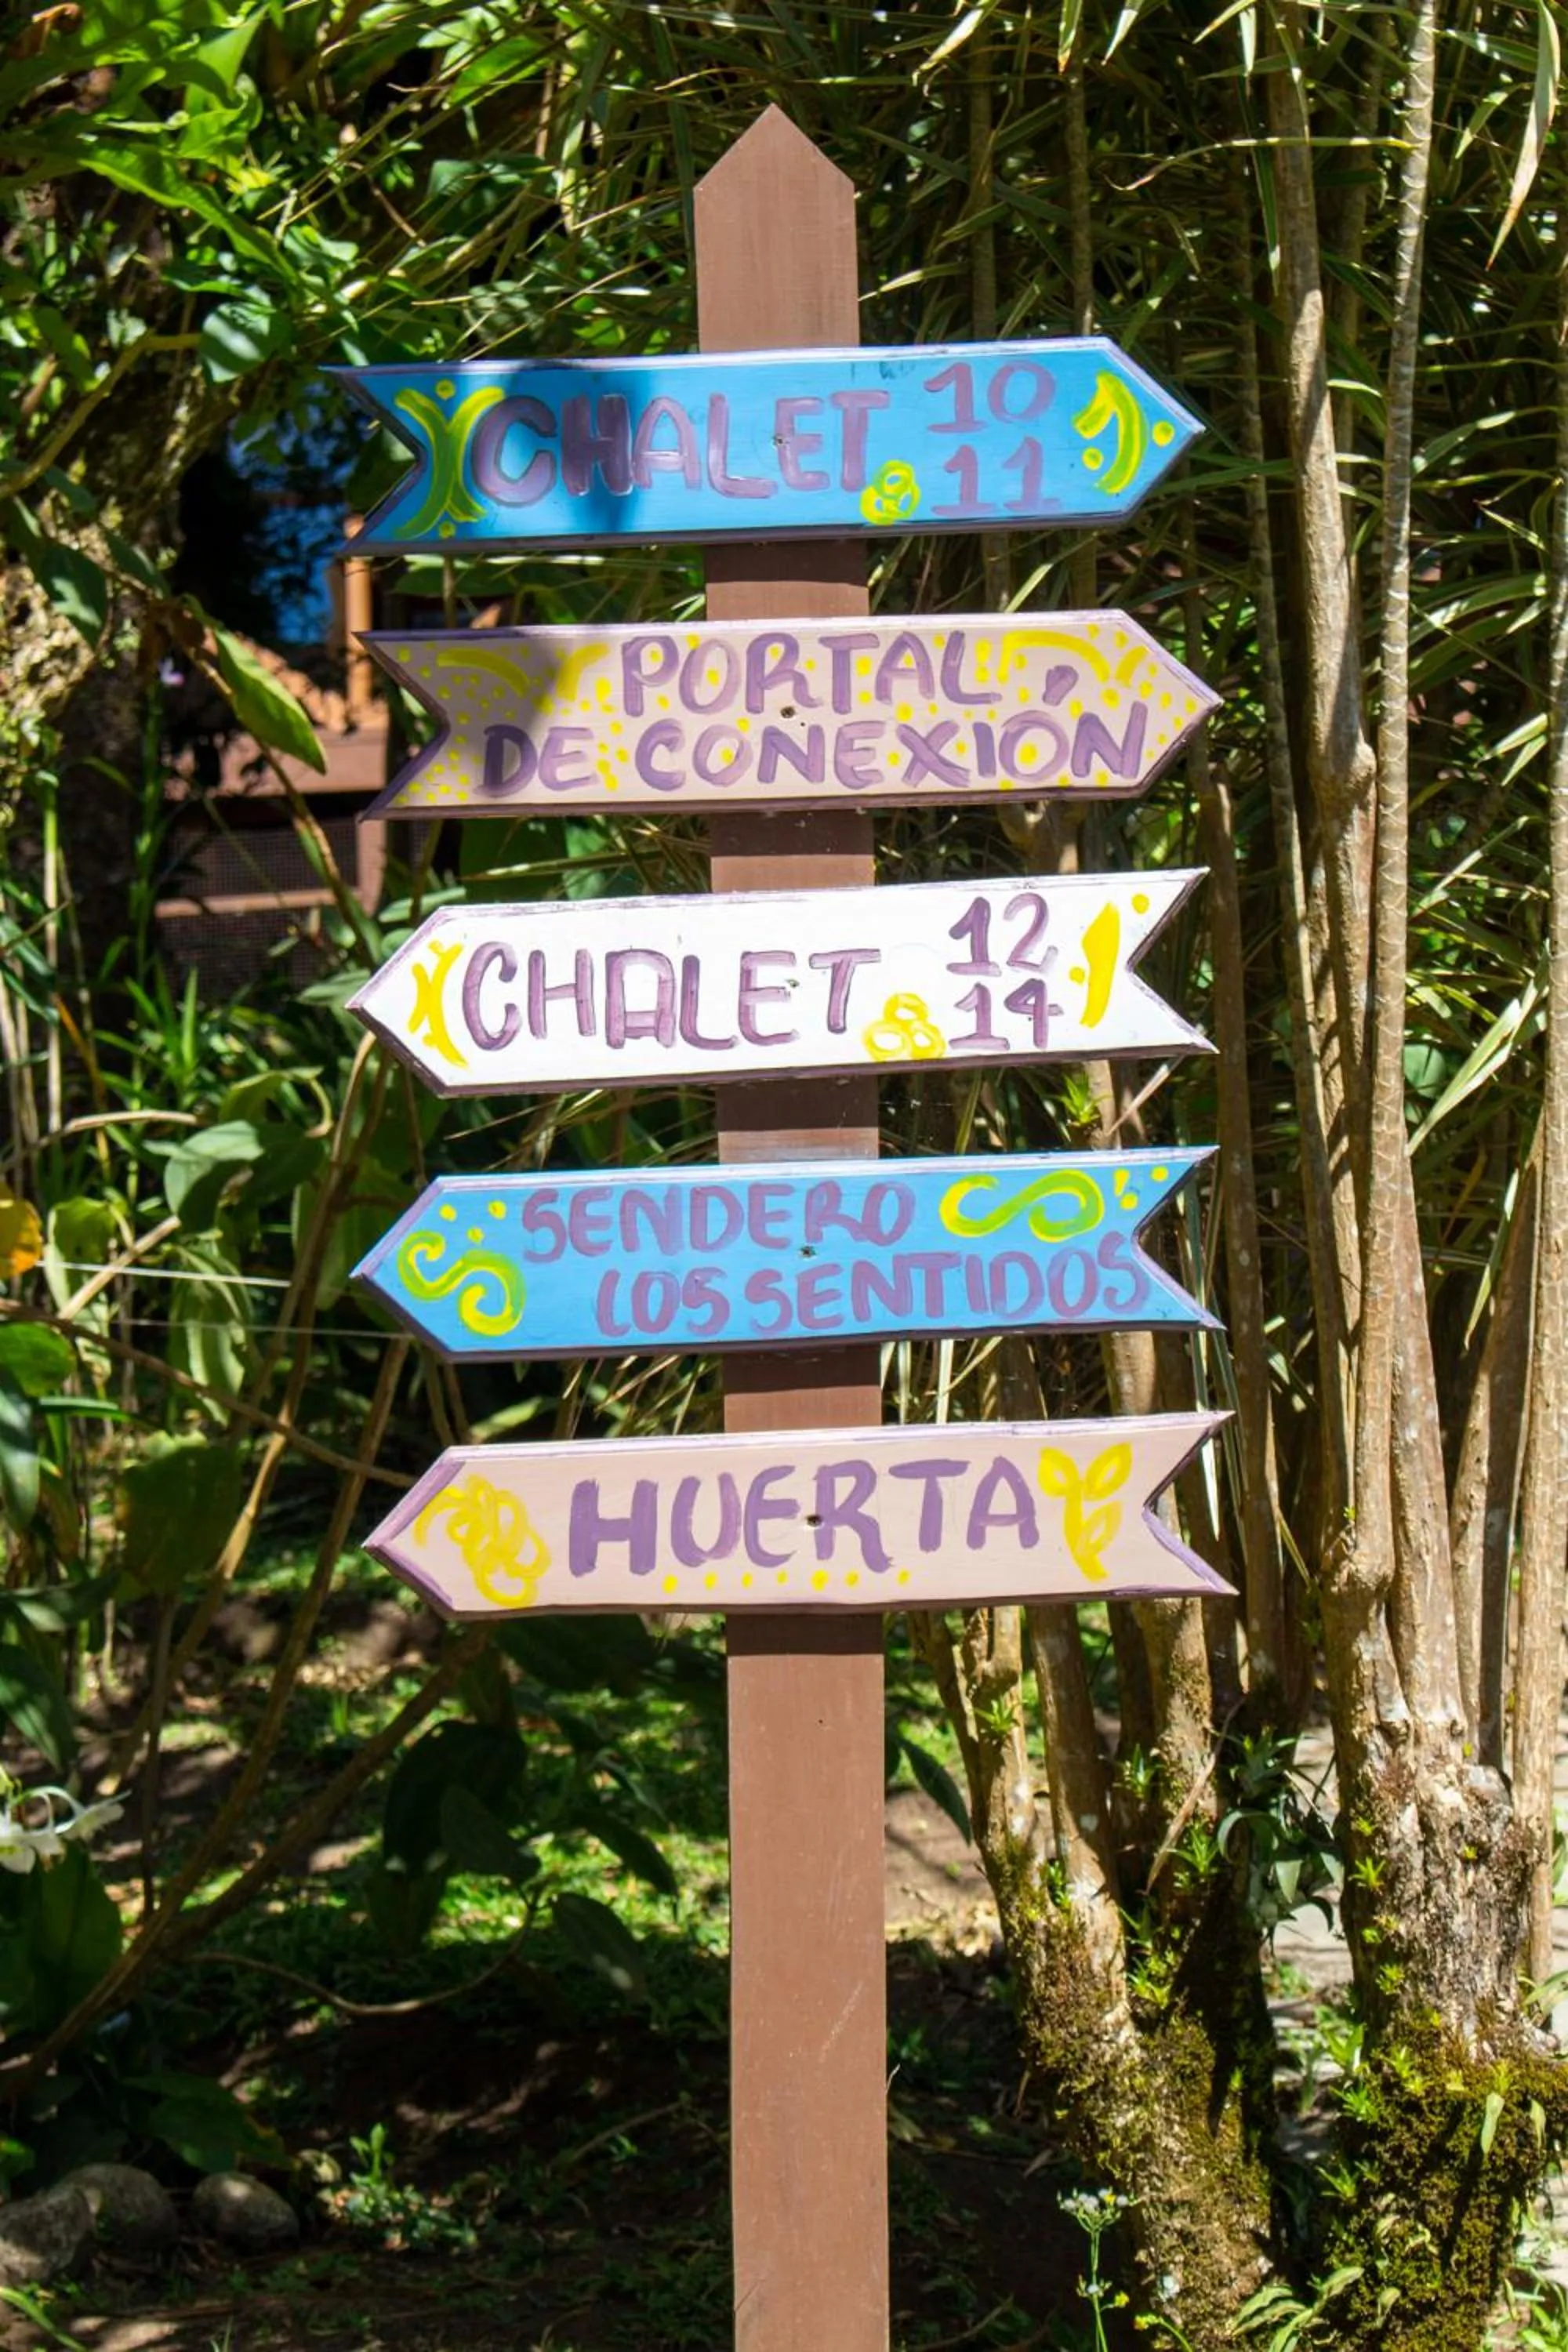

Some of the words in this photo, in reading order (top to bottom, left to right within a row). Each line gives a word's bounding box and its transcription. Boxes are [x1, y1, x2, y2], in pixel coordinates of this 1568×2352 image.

[924, 360, 1057, 433] 10
[476, 390, 890, 506] CHALET
[929, 436, 1062, 516] 11
[621, 629, 1003, 717] PORTAL
[482, 722, 599, 789] DE
[947, 892, 1058, 976] 12
[463, 940, 883, 1051] CHALET
[948, 978, 1064, 1052] 14
[521, 1181, 916, 1263] SENDERO
[597, 1268, 731, 1336] LOS
[750, 1229, 1151, 1331] SENTIDOS
[568, 1454, 1040, 1577] HUERTA
